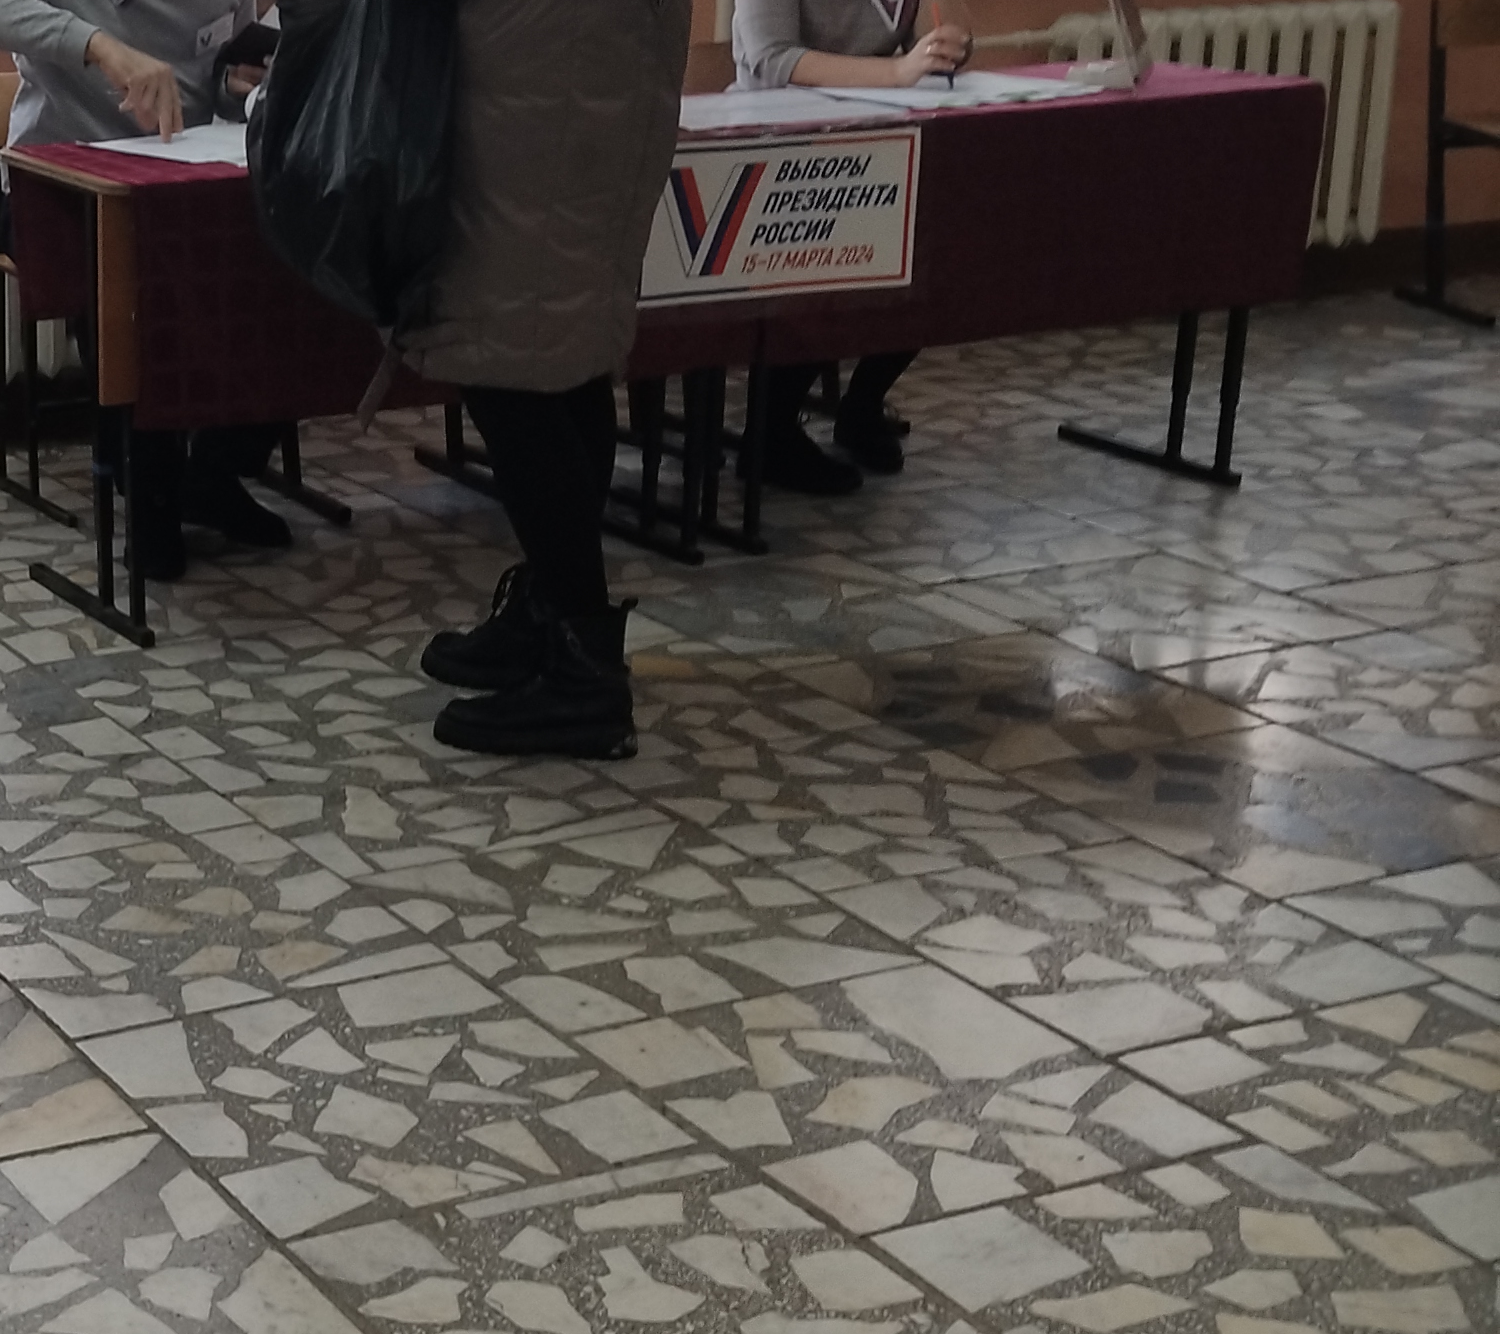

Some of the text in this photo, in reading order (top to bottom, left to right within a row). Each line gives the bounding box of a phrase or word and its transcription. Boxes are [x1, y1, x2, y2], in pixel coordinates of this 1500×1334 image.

[775, 154, 872, 183] ВЫБОРЫ
[762, 183, 898, 215] ПРЕЗИДЕНТА
[750, 218, 837, 247] РОССИИ
[784, 247, 832, 269] МАРТА
[836, 244, 874, 265] 2024
